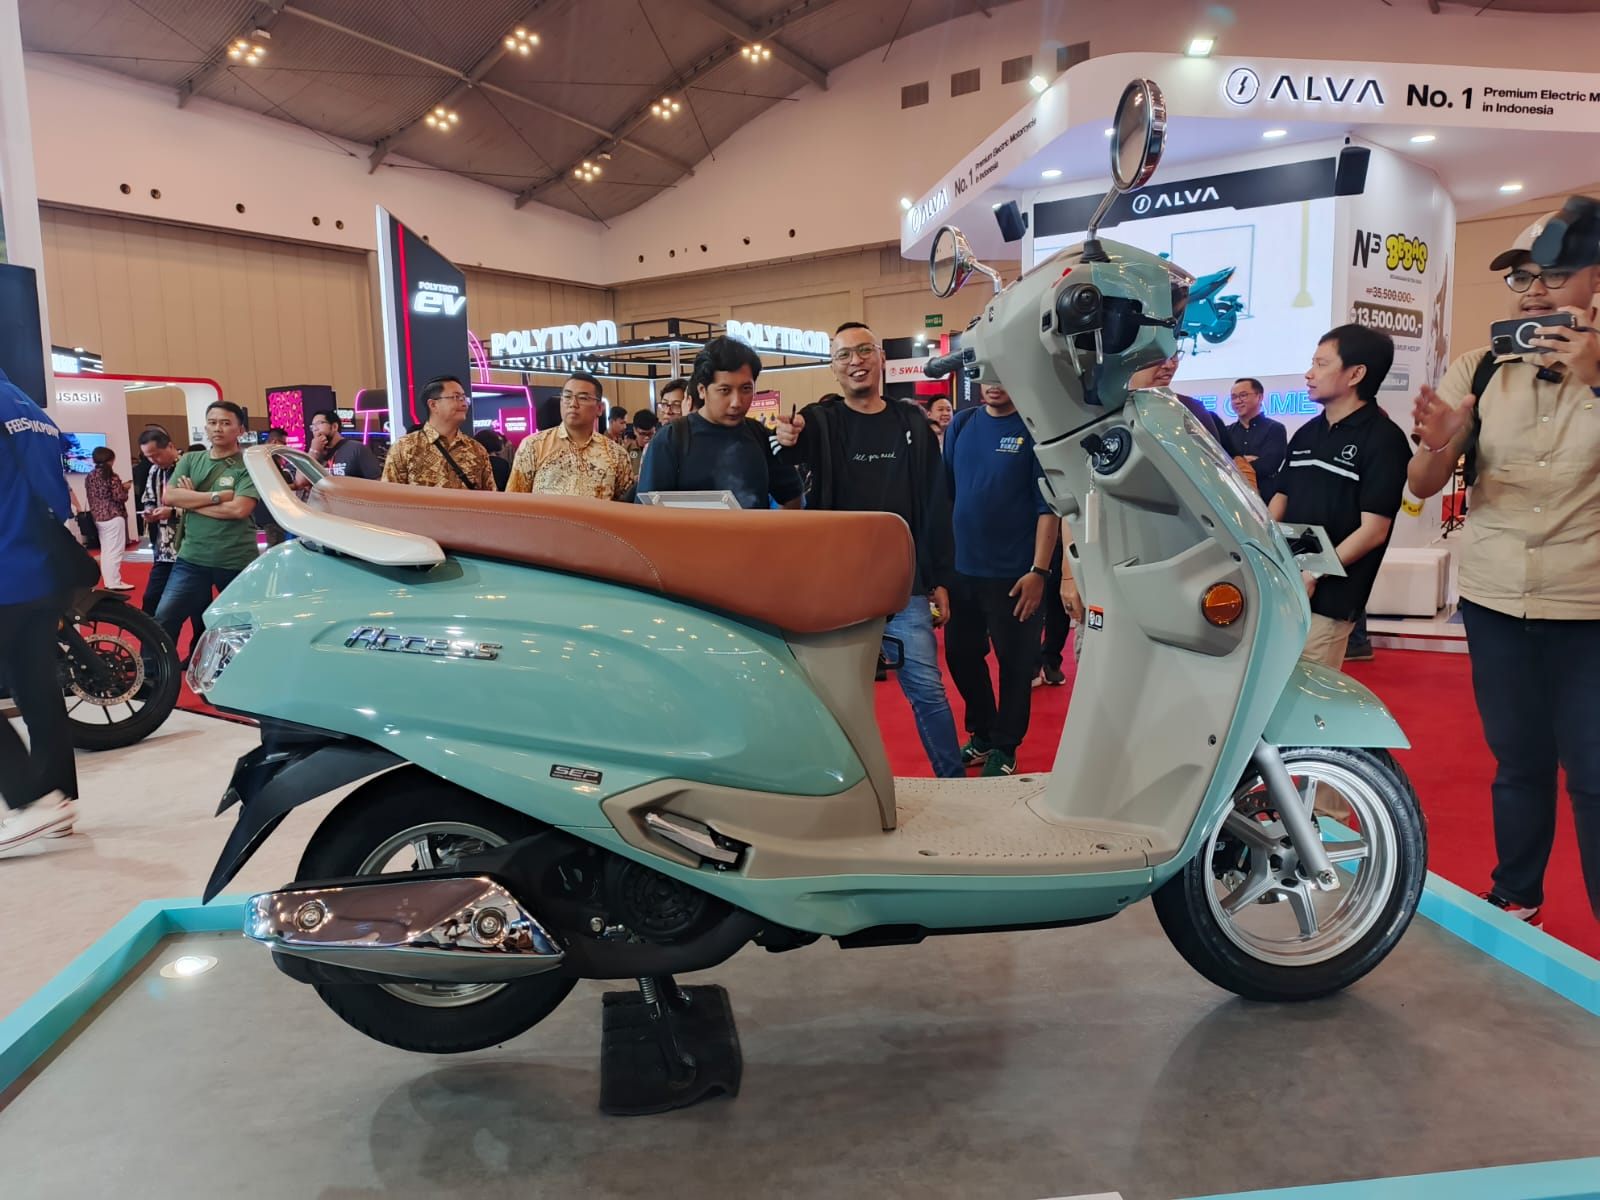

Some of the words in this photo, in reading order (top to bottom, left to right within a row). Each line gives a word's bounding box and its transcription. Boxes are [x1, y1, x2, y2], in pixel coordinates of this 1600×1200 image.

[1269, 75, 1385, 104] ALVA
[1407, 84, 1453, 109] No.
[1461, 87, 1473, 109] 1
[1483, 87, 1537, 99] Premium
[1540, 89, 1586, 101] Electric
[1482, 102, 1493, 112] in
[1496, 103, 1553, 115] Indonesia
[955, 178, 968, 197] No.
[1154, 186, 1220, 209] ALVA
[1386, 233, 1428, 274] BEBAS
[418, 281, 459, 294] POLYTRON
[491, 319, 617, 357] POLYTRON
[727, 319, 830, 357] POLYTRON
[553, 766, 599, 778] SEP
